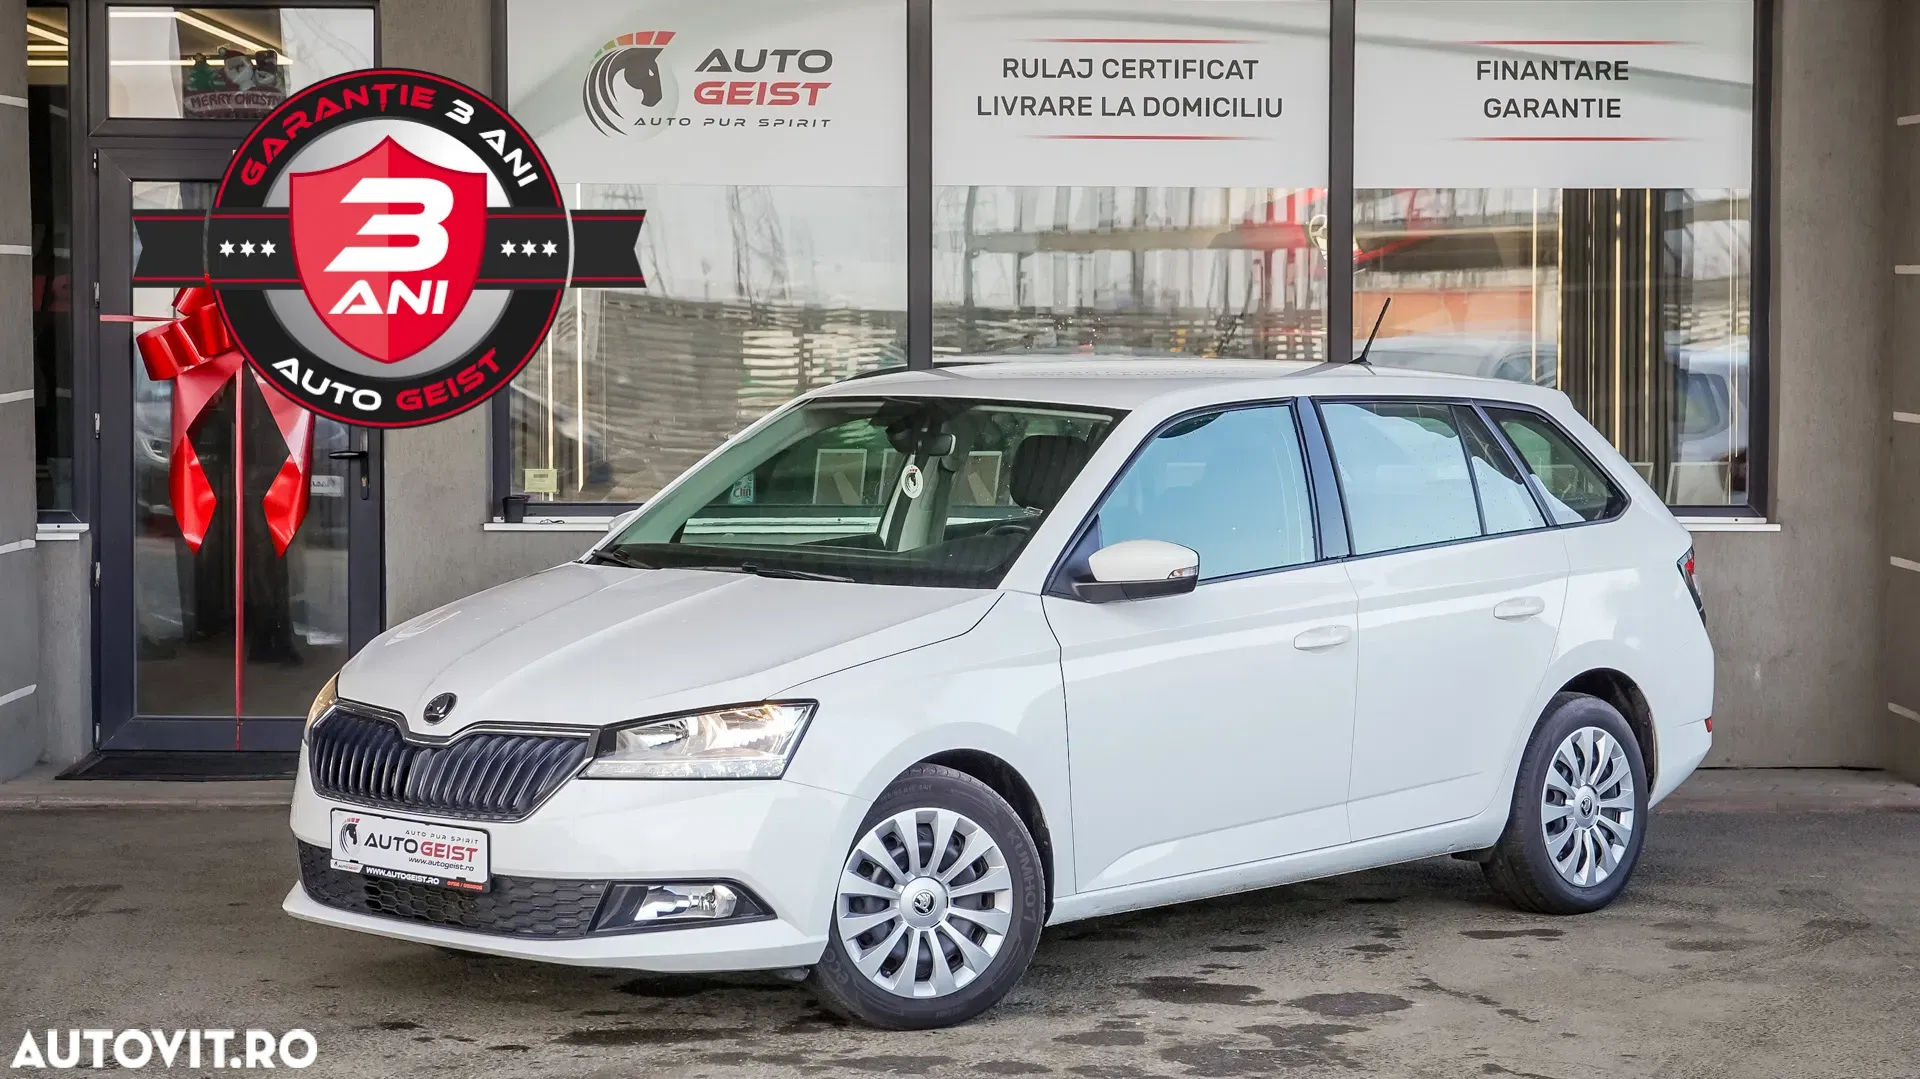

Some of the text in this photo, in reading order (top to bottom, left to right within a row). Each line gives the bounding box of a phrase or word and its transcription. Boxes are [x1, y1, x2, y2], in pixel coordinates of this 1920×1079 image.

[694, 48, 833, 74] AUTO
[1002, 58, 1259, 80] RULAJ CERTIFICAT
[1476, 60, 1629, 80] FINANTARE
[190, 94, 232, 109] MERRY
[694, 81, 832, 106] GEIST
[977, 95, 1283, 118] LIVRARE LA DOMICILIU
[1484, 98, 1621, 118] GARANTIE
[634, 117, 831, 128] AUTO PUR SPIRIT
[405, 829, 479, 845] AUTO PUR SPIRIT
[408, 856, 475, 872] www.autogeist.ro
[1007, 827, 1037, 908] KUMHO
[365, 866, 440, 885] WWW.AUTOGEIST.RO
